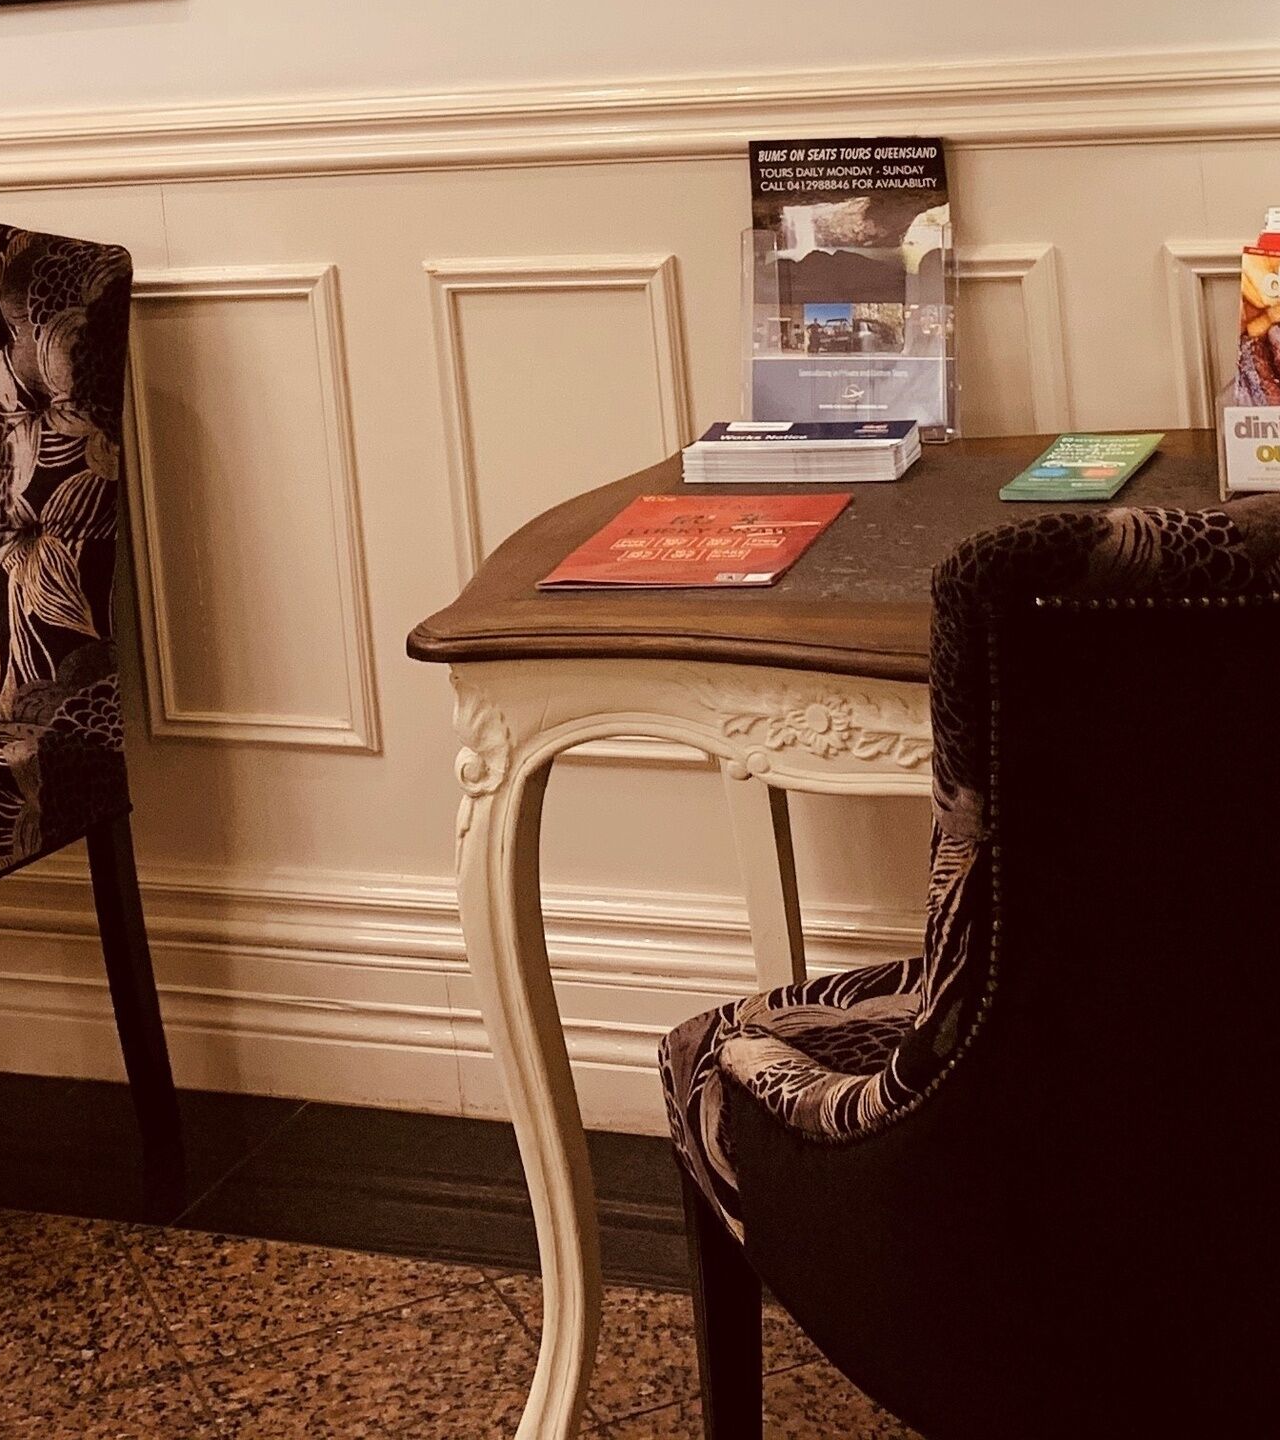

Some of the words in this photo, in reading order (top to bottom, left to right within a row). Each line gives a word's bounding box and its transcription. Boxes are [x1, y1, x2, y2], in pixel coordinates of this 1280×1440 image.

[757, 149, 788, 163] BUMS
[789, 148, 805, 162] ON
[807, 148, 838, 162] SEATS
[839, 147, 873, 161] TOURS
[874, 146, 938, 161] QUEENSLAND
[759, 167, 793, 179] TOURS
[795, 167, 825, 179] DAILY
[826, 166, 874, 177] MONDAY
[882, 165, 925, 177] SUNDAY
[760, 180, 786, 192] CALL
[852, 179, 873, 190] FOR
[875, 178, 938, 189] AVAILABILITY
[719, 433, 763, 442] Works
[765, 433, 809, 441] Notice
